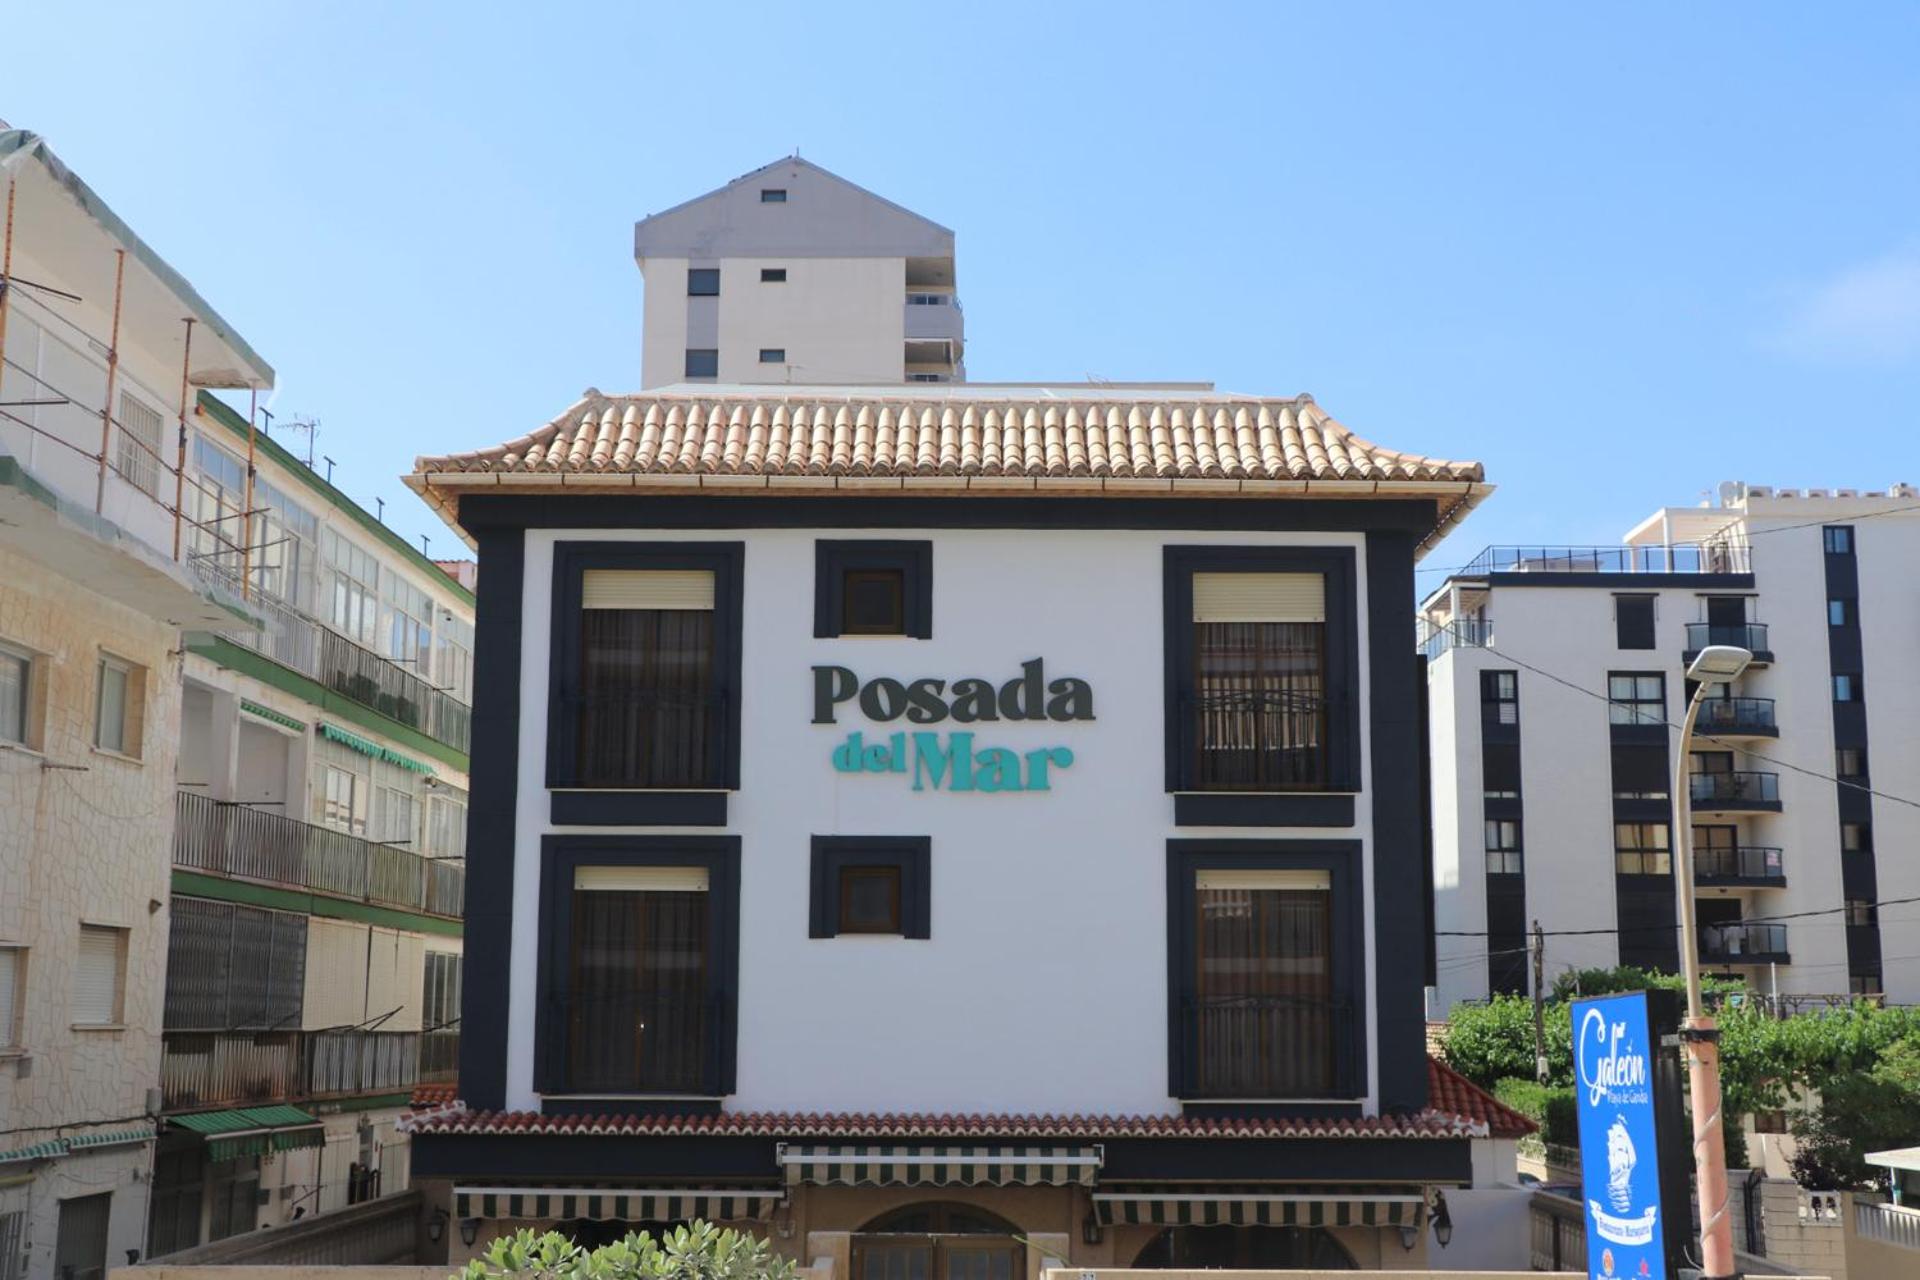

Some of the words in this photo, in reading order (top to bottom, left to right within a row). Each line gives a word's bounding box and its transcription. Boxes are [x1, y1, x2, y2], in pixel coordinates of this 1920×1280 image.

[811, 657, 1096, 724] Posada
[832, 732, 906, 773] del
[912, 732, 1074, 792] Mar
